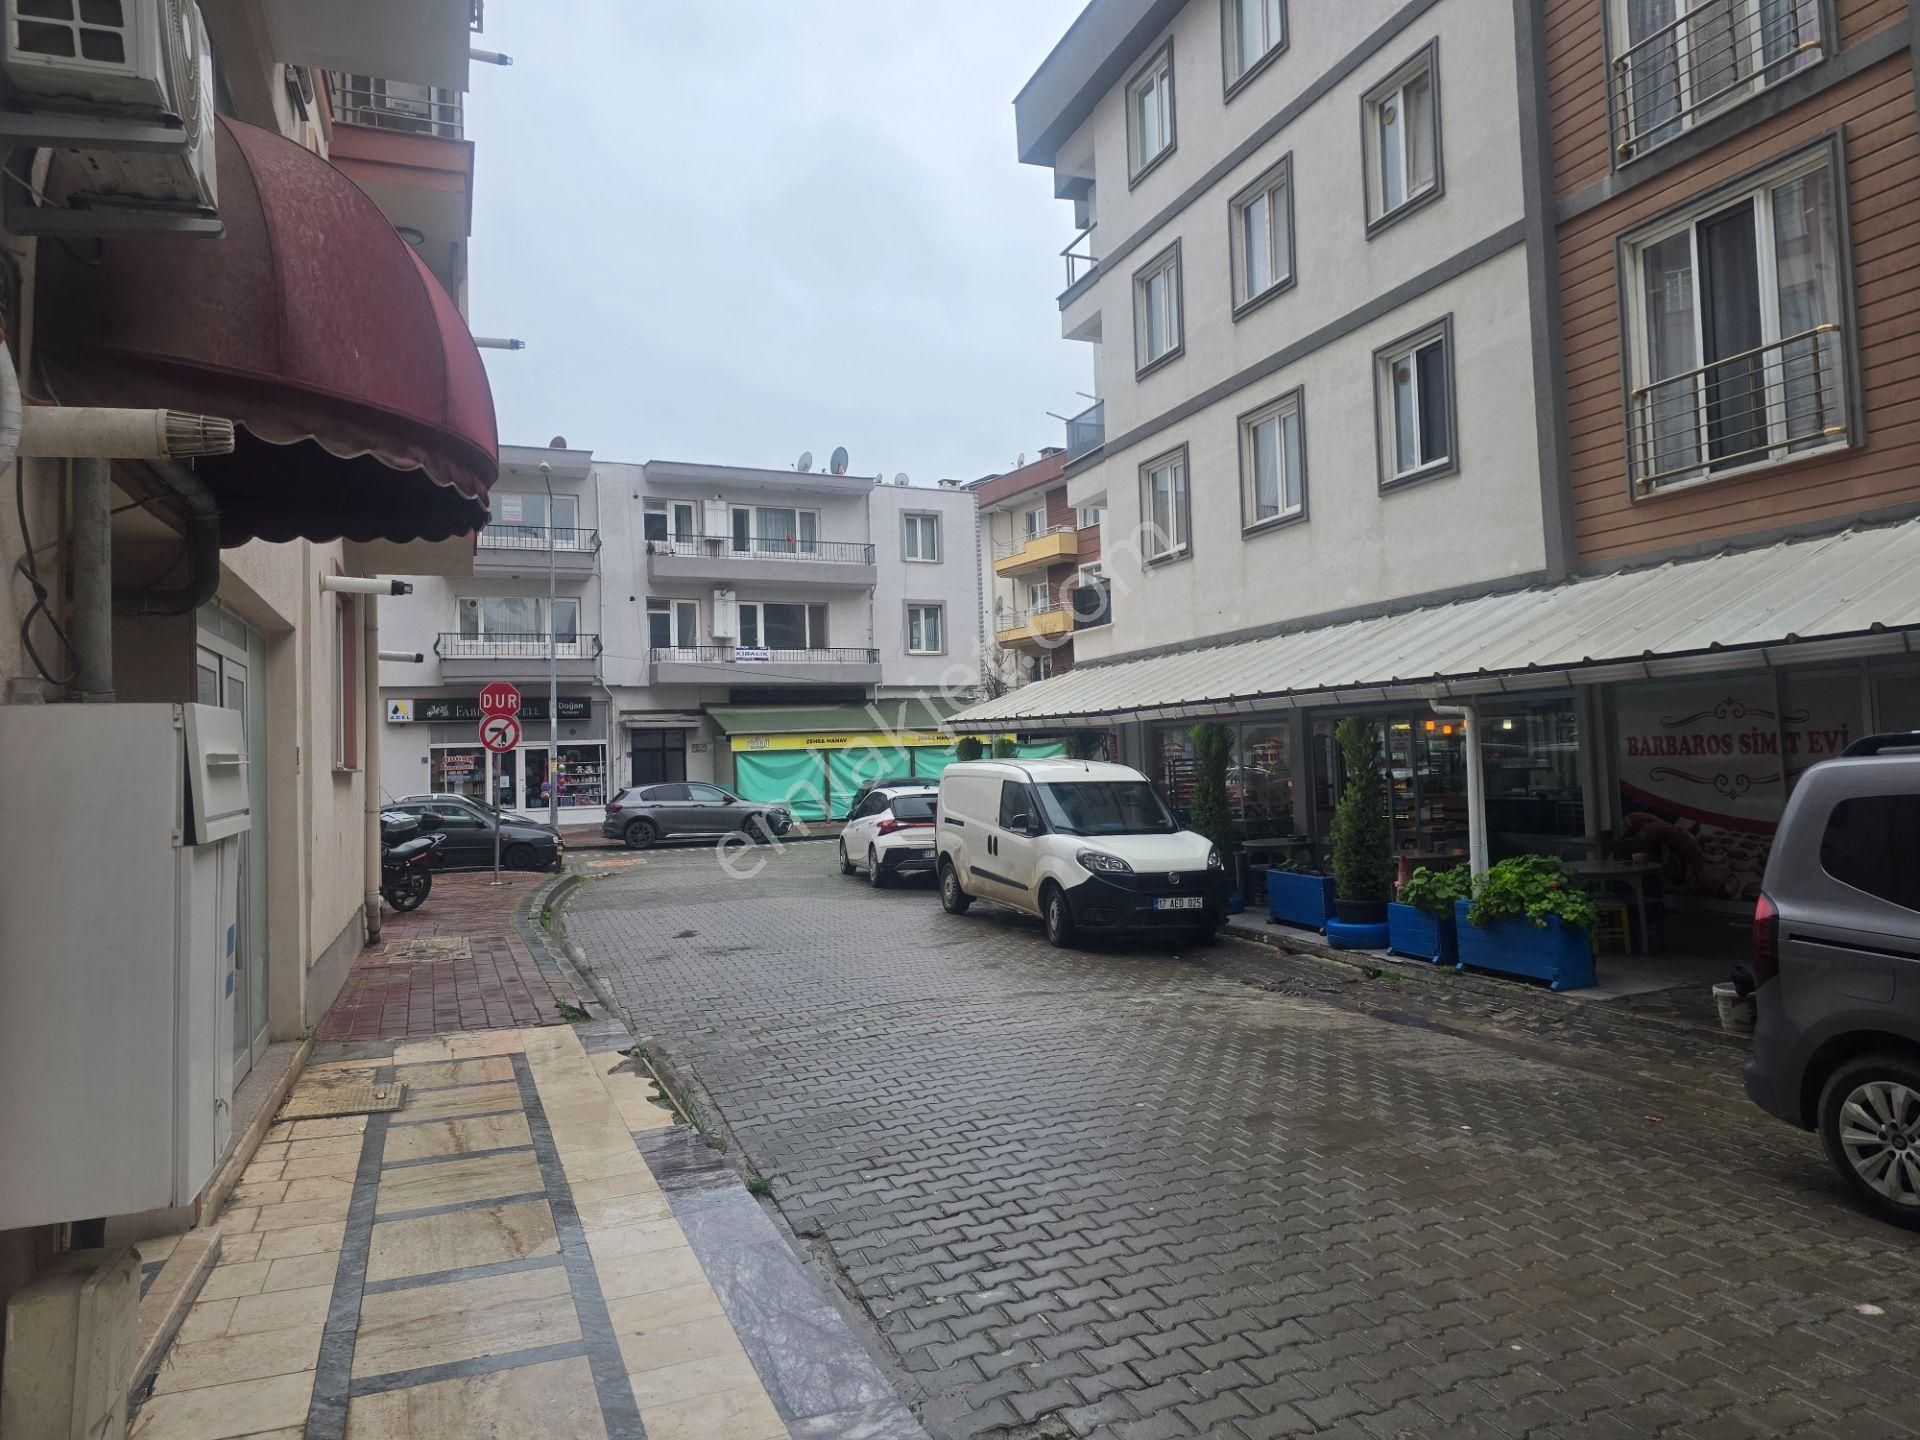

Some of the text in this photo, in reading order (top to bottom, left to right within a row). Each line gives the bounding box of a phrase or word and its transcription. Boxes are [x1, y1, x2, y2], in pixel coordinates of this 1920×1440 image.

[483, 693, 518, 709] DUR
[558, 702, 584, 710] Doğan
[1627, 734, 1733, 757] BARBAROS
[1808, 723, 1850, 754] EVİ
[1188, 898, 1201, 907] 025
